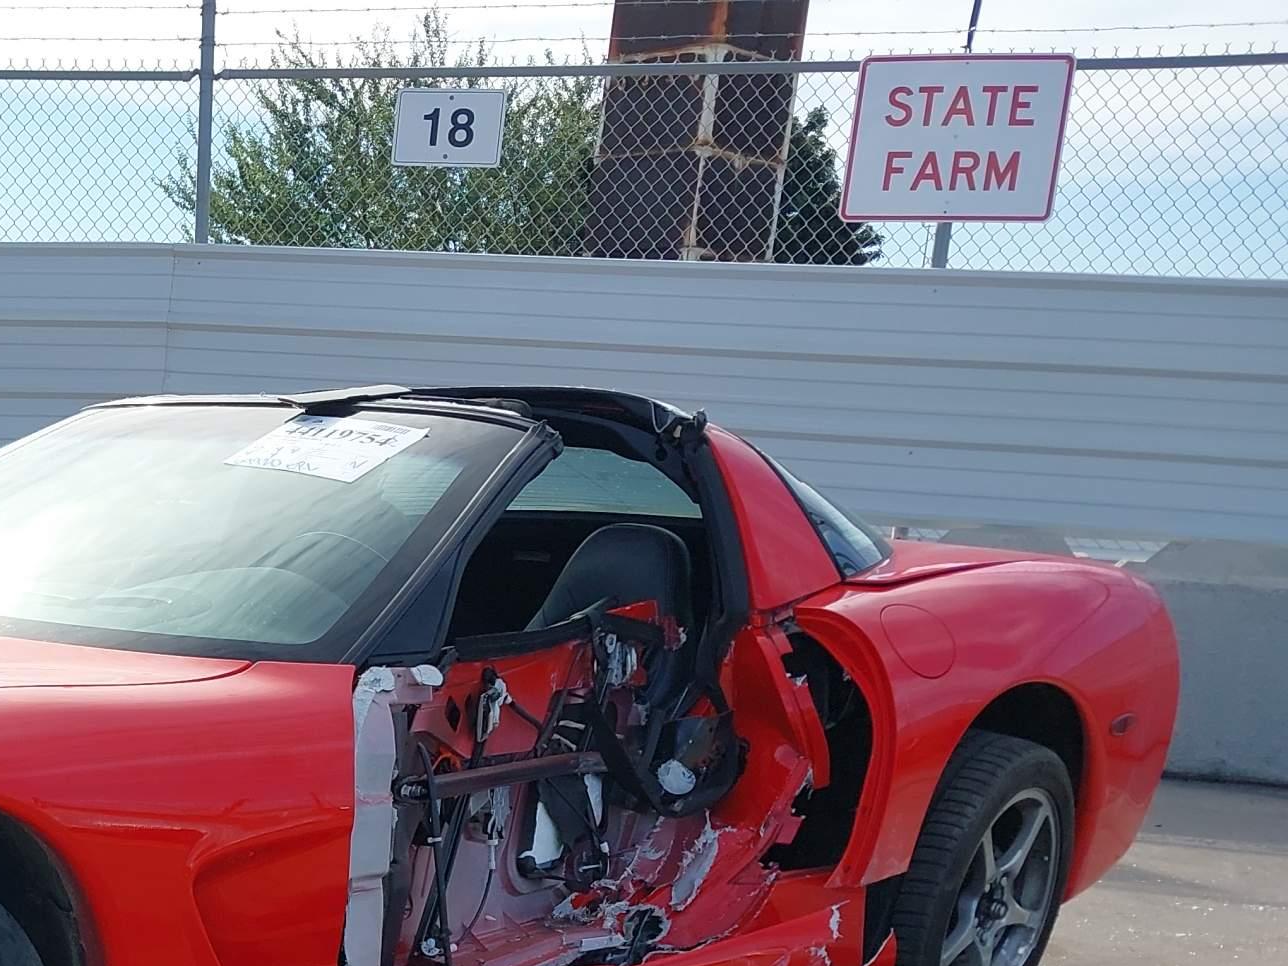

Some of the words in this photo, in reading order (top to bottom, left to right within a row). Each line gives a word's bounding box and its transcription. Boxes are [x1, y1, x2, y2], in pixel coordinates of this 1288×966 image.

[422, 107, 475, 148] 18
[884, 85, 1038, 128] STATE
[881, 150, 1022, 193] FARM
